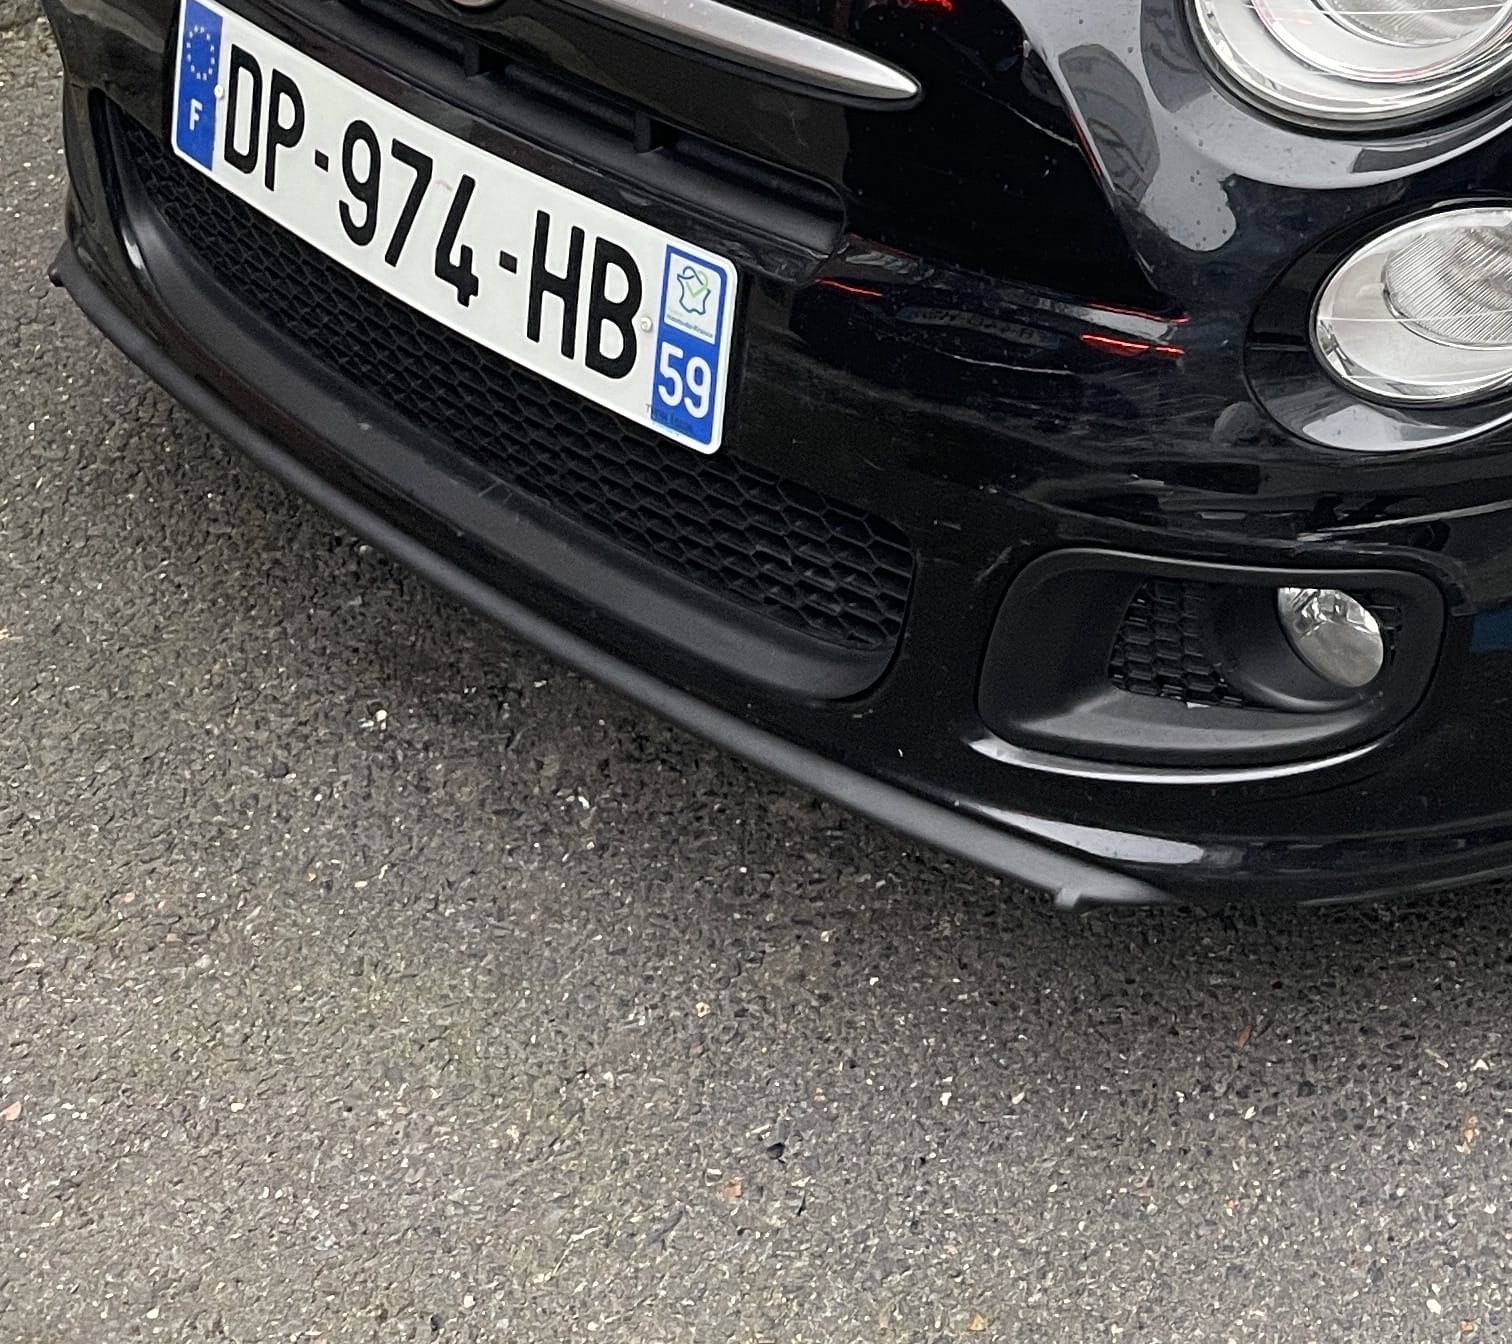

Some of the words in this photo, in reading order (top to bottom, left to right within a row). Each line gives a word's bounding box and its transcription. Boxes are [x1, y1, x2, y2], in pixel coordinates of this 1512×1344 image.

[189, 97, 203, 131] F
[223, 43, 643, 380] DP-974-HB
[657, 341, 712, 419] 59
